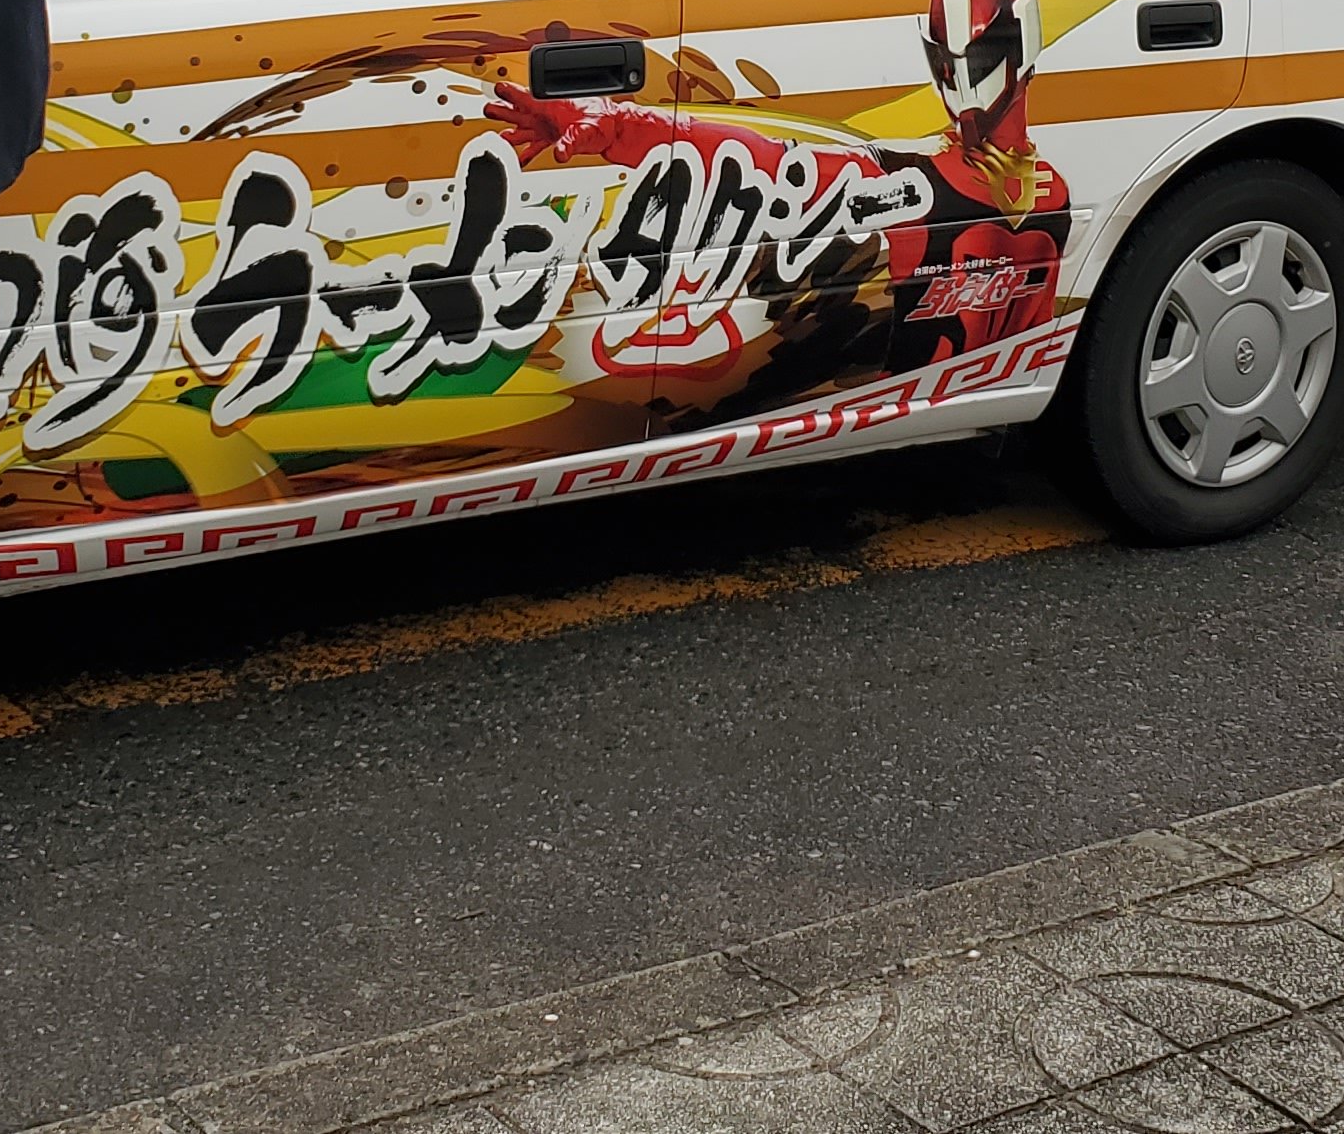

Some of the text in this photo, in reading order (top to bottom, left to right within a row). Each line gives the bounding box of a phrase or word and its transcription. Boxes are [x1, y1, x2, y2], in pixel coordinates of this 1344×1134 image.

[914, 256, 1014, 277] 白河のラーメン大好きヒーロー
